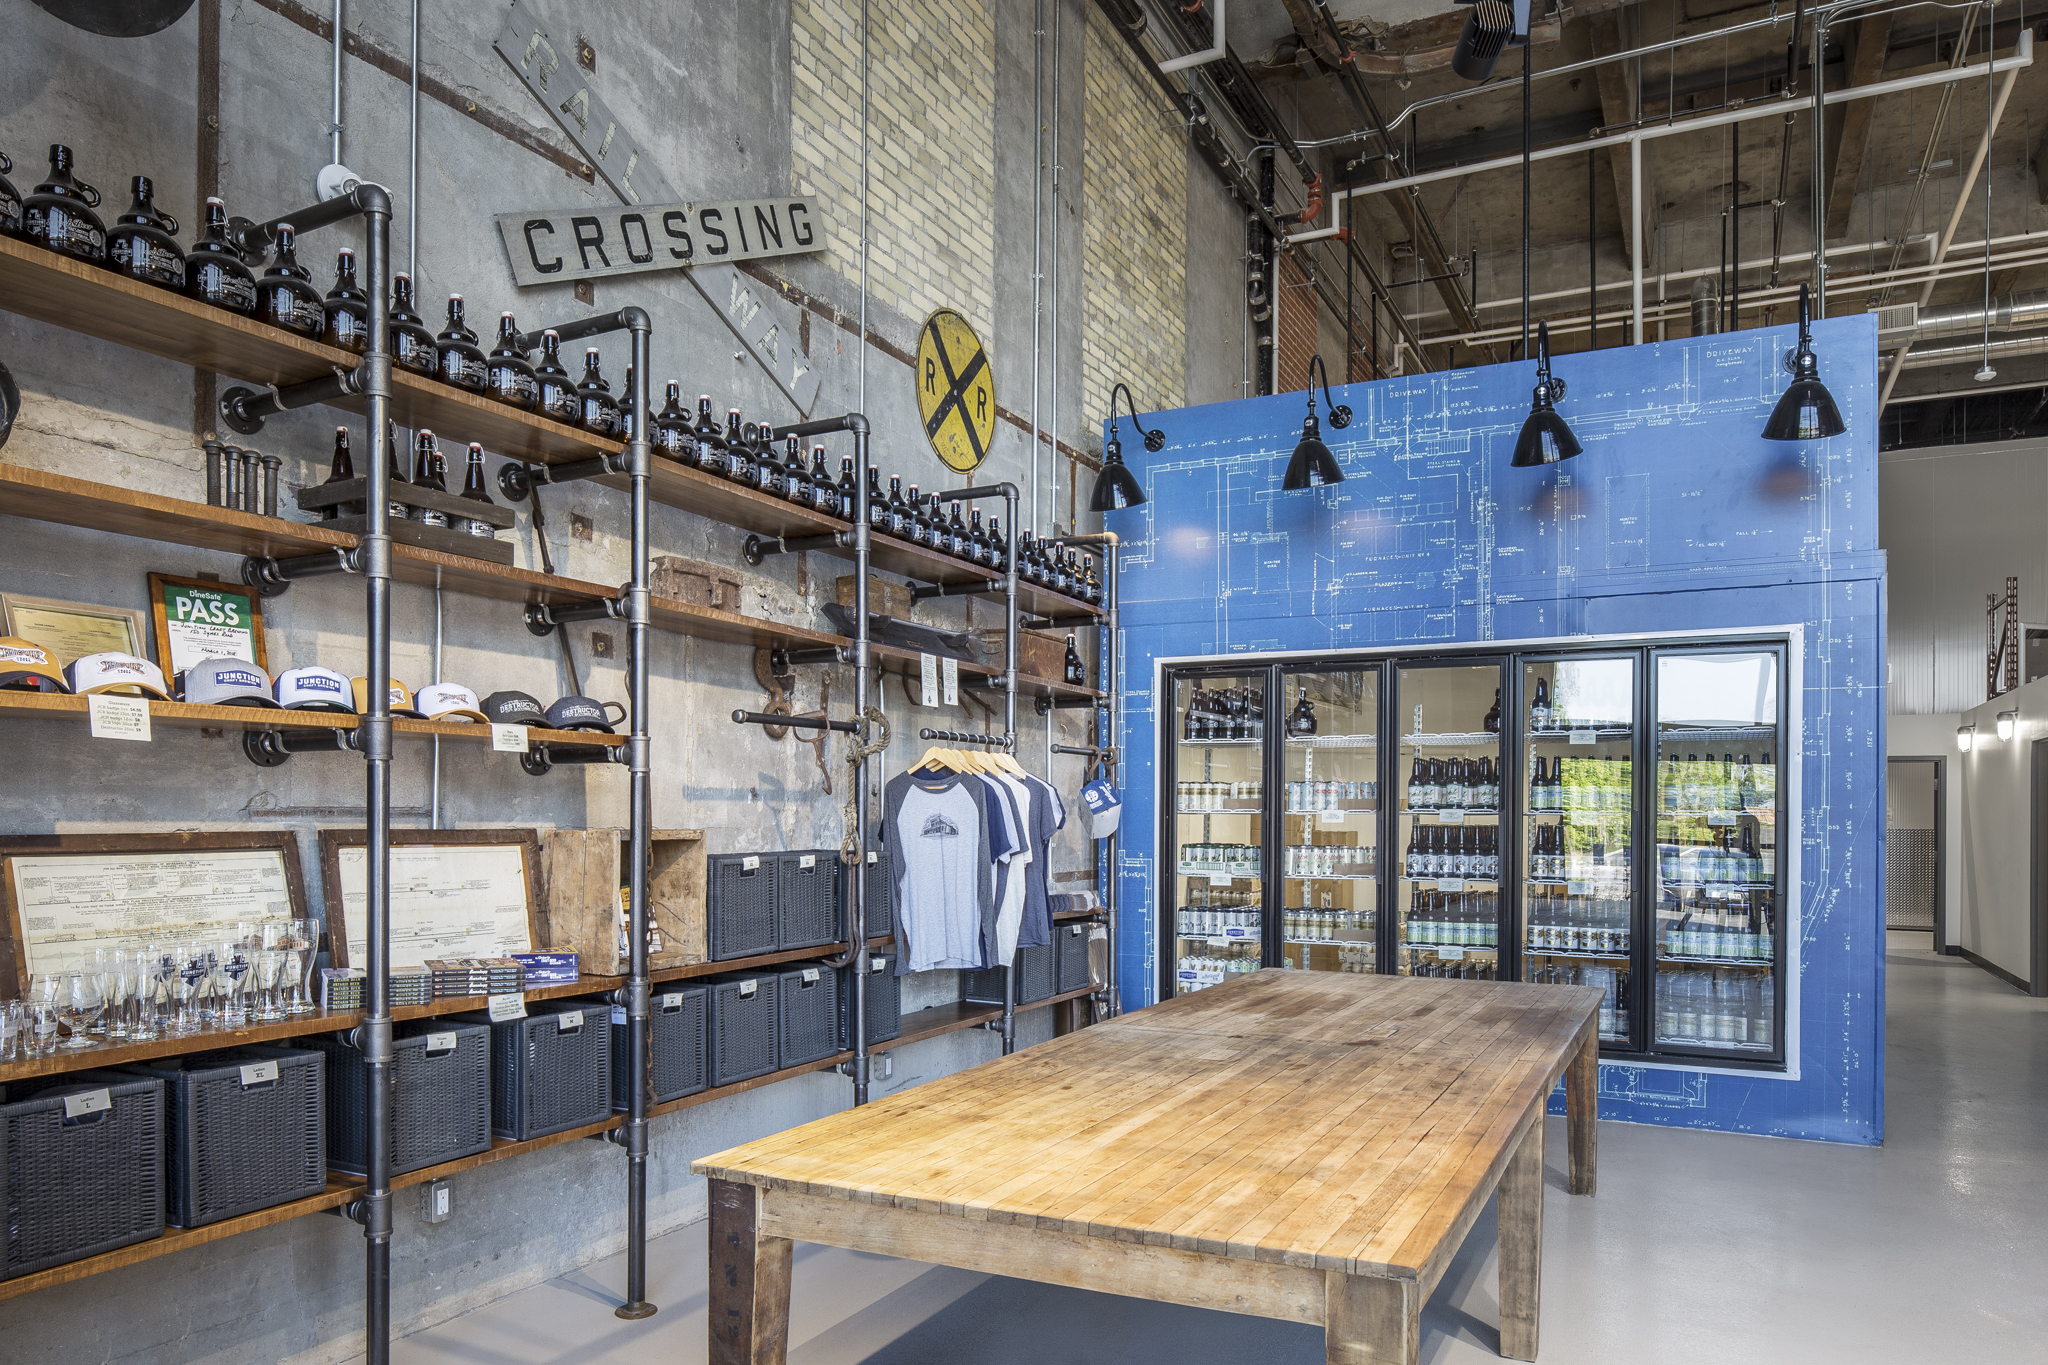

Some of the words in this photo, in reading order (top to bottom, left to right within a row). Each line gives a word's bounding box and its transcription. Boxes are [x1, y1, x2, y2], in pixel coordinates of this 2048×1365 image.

[520, 28, 641, 203] RAIL
[728, 272, 810, 390] WAY
[523, 202, 814, 274] CROSSING
[925, 356, 936, 396] R
[976, 385, 987, 422] R
[189, 590, 221, 600] DineSafe
[176, 596, 239, 626] PASS
[217, 672, 261, 684] JUNCTION
[297, 678, 340, 689] JUNCTION
[499, 701, 541, 714] DESTRUCTOR
[561, 707, 601, 720] DESTRUCTOR
